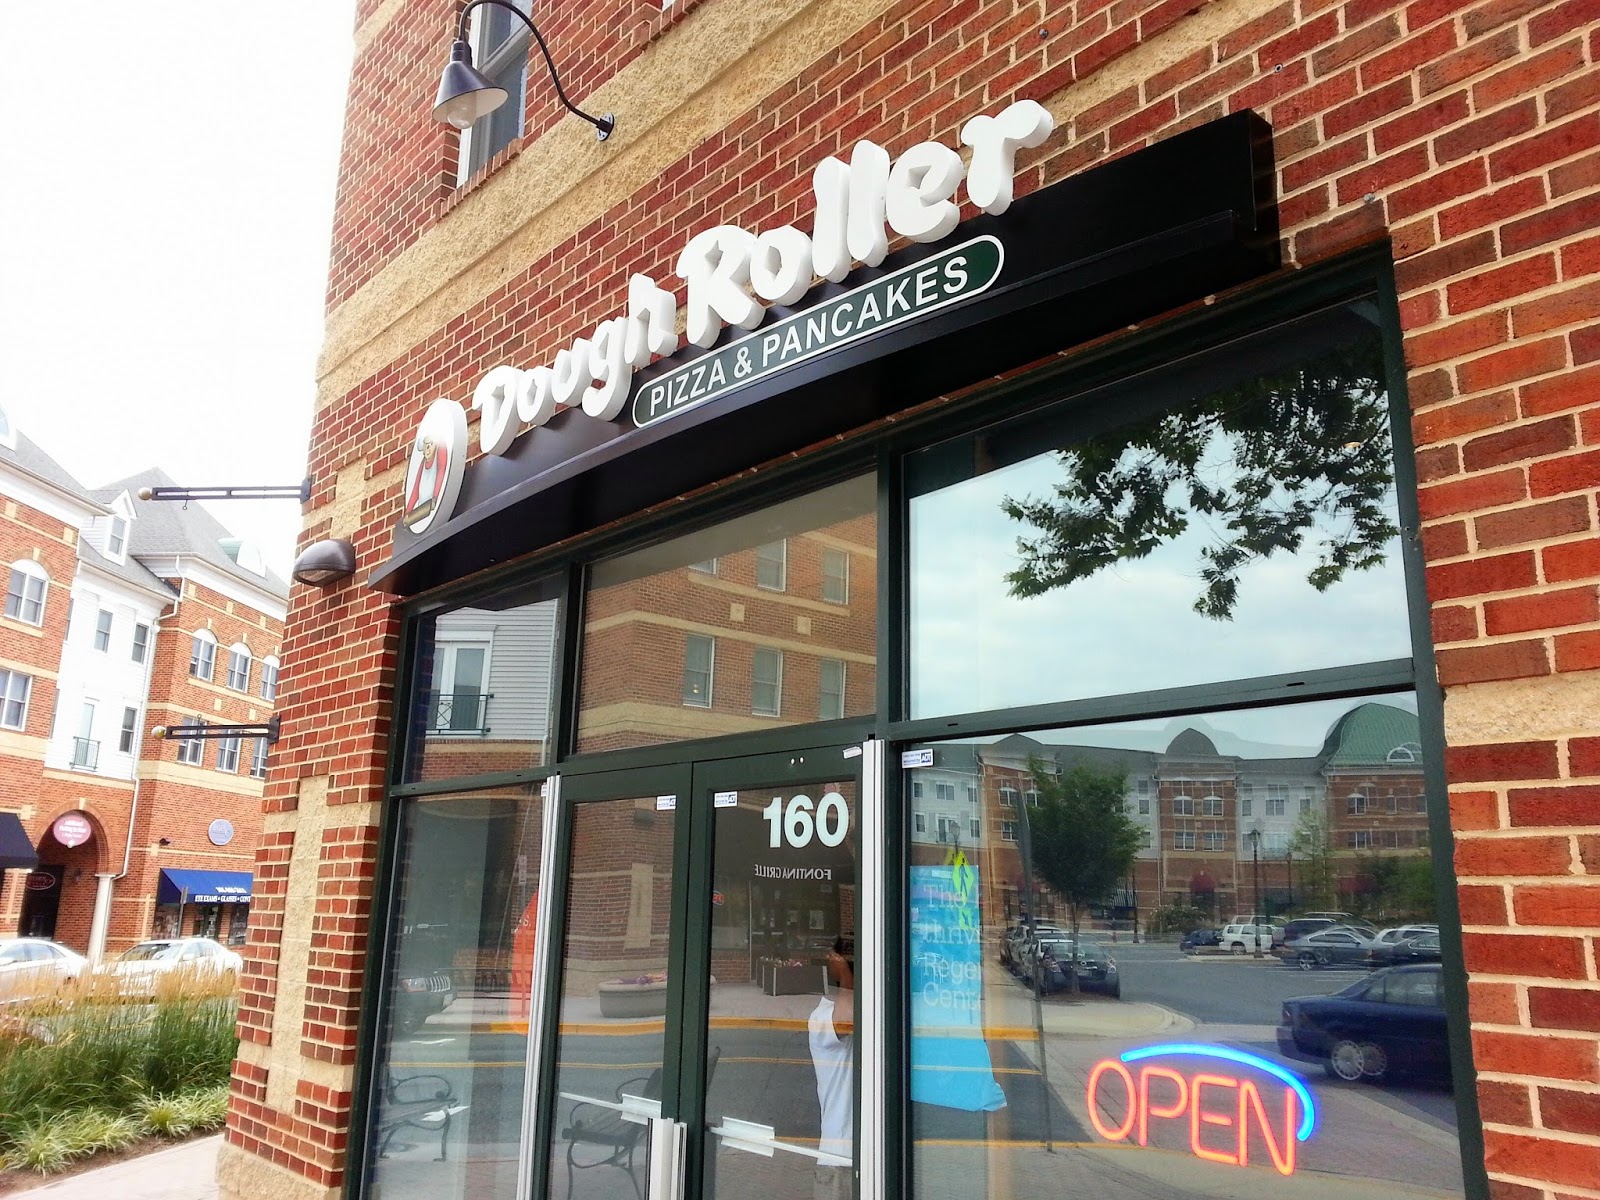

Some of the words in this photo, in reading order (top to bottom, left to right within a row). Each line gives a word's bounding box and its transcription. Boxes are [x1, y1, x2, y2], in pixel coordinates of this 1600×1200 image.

[472, 273, 678, 456] Dough
[675, 99, 1053, 350] Roller
[650, 358, 726, 416] PIZZA
[733, 346, 753, 379] &
[762, 255, 969, 368] PANCAKES
[763, 792, 849, 848] 160
[923, 952, 981, 985] Rege
[1087, 1059, 1296, 1177] OPEN
